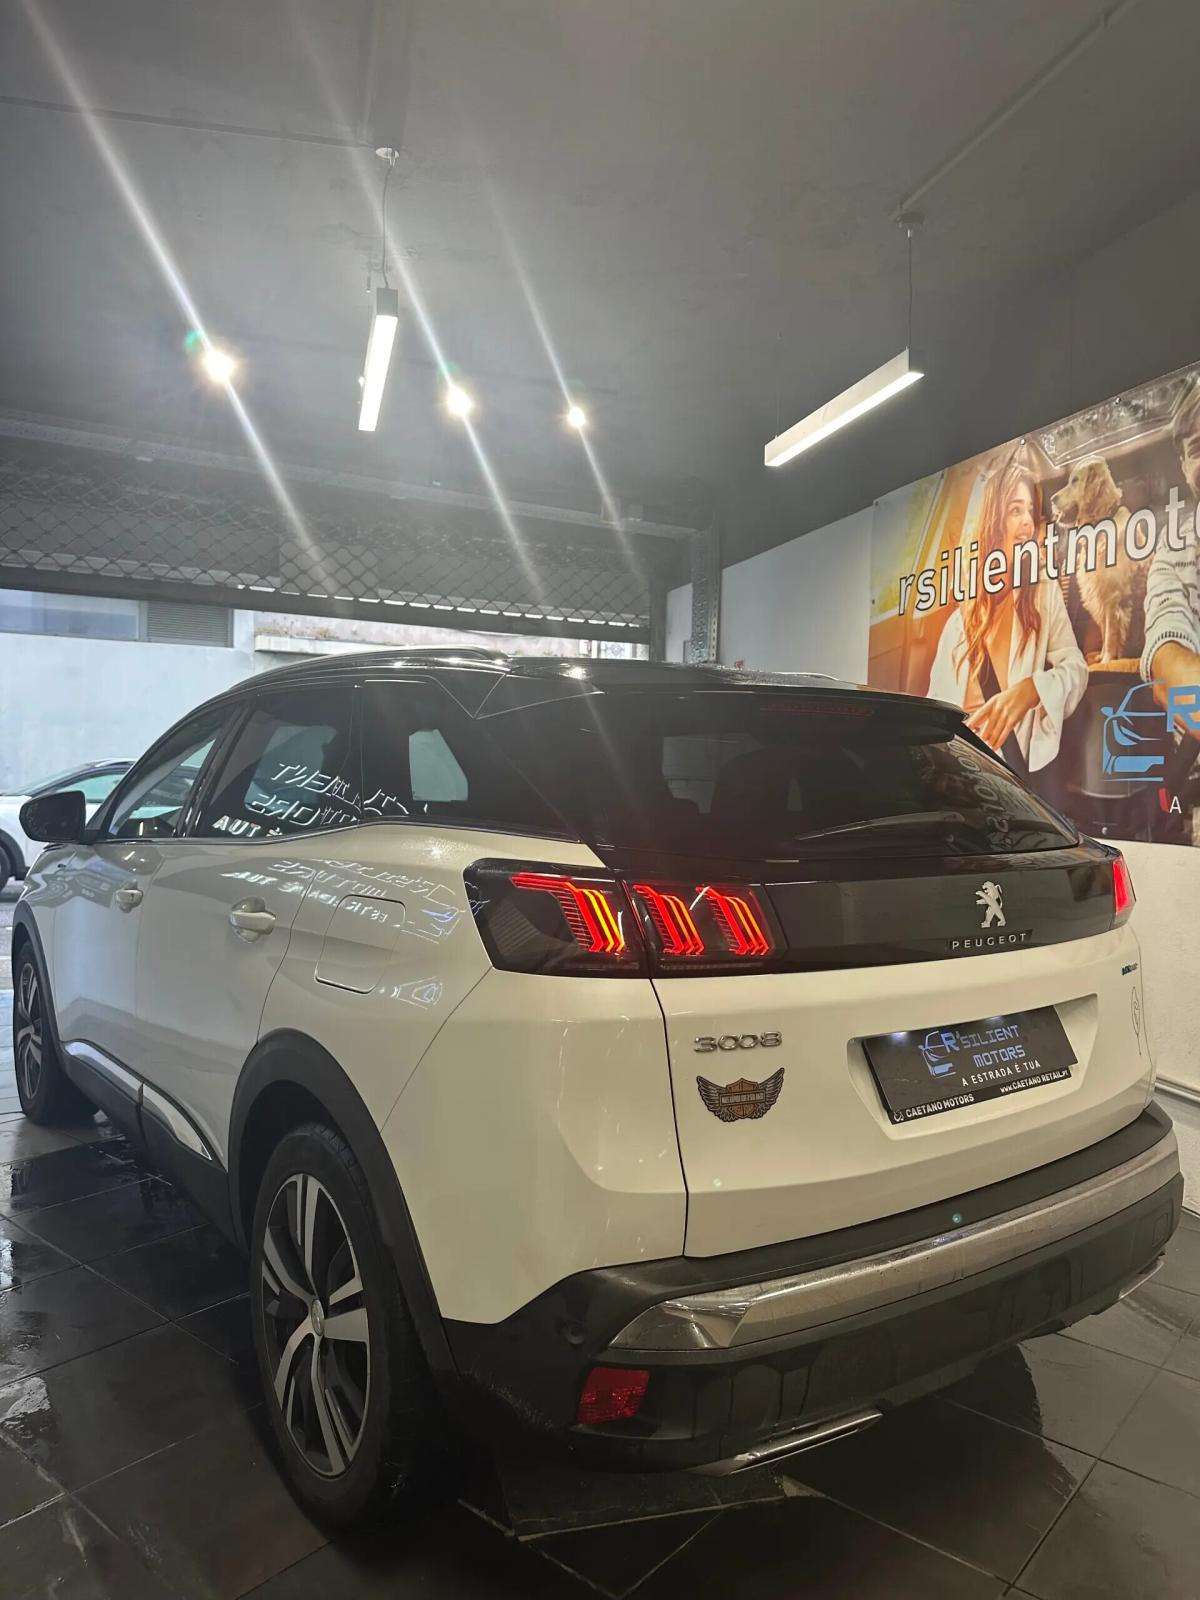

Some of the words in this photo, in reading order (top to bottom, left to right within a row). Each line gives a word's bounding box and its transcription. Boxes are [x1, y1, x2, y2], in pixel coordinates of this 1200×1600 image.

[898, 486, 1200, 617] rsilientmot
[1169, 795, 1182, 814] A
[951, 933, 1027, 950] PEUGEOT
[693, 1031, 783, 1053] 3008
[972, 1044, 1026, 1068] MOTORS
[961, 1077, 969, 1087] A
[970, 1066, 1013, 1084] ESTRADA
[1023, 1059, 1041, 1071] TUA
[905, 1101, 943, 1118] CAETANO
[943, 1093, 975, 1109] MOTORS
